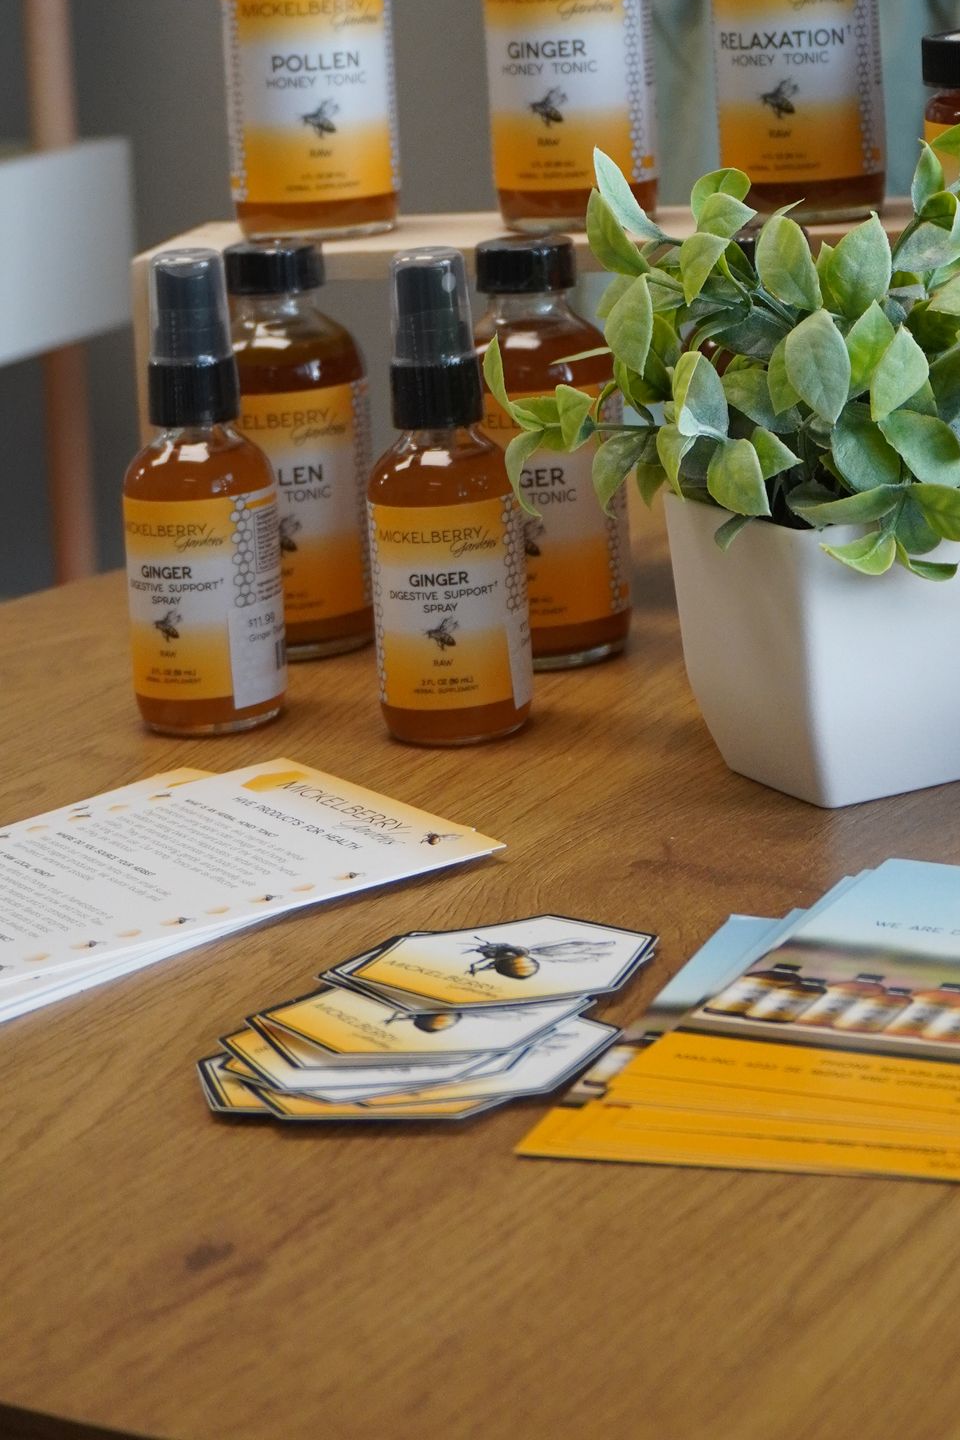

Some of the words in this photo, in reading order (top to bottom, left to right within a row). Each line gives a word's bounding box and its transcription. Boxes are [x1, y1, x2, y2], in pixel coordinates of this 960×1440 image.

[507, 39, 587, 59] GINGER
[270, 51, 360, 73] POLLEN
[502, 63, 544, 76] HONEY
[551, 60, 598, 75] TONIC
[731, 54, 775, 67] HONEY
[782, 51, 830, 66] TONIC
[265, 75, 316, 90] HONEY
[326, 71, 367, 86] TONIC
[278, 464, 324, 487] LEN
[284, 485, 331, 503] TONIC
[528, 488, 577, 505] TONIC
[173, 527, 226, 553] Gardens
[378, 525, 483, 544] MICKELBERRY
[449, 529, 497, 558] Gardens
[141, 565, 193, 580] GINGER
[408, 570, 470, 588] GINGER
[151, 596, 182, 606] SPRAY
[389, 590, 439, 601] DIGESTIVE
[423, 602, 458, 614] SPRAY
[248, 611, 275, 629] $11.99
[248, 630, 272, 643] Ginger
[433, 658, 455, 667] RAW
[276, 780, 413, 833] MICKELBERRY
[254, 804, 305, 827] PRODUCTS
[302, 823, 326, 836] FOR
[322, 832, 363, 851] HEALTH
[875, 920, 903, 929] WE
[907, 925, 944, 935] ARE
